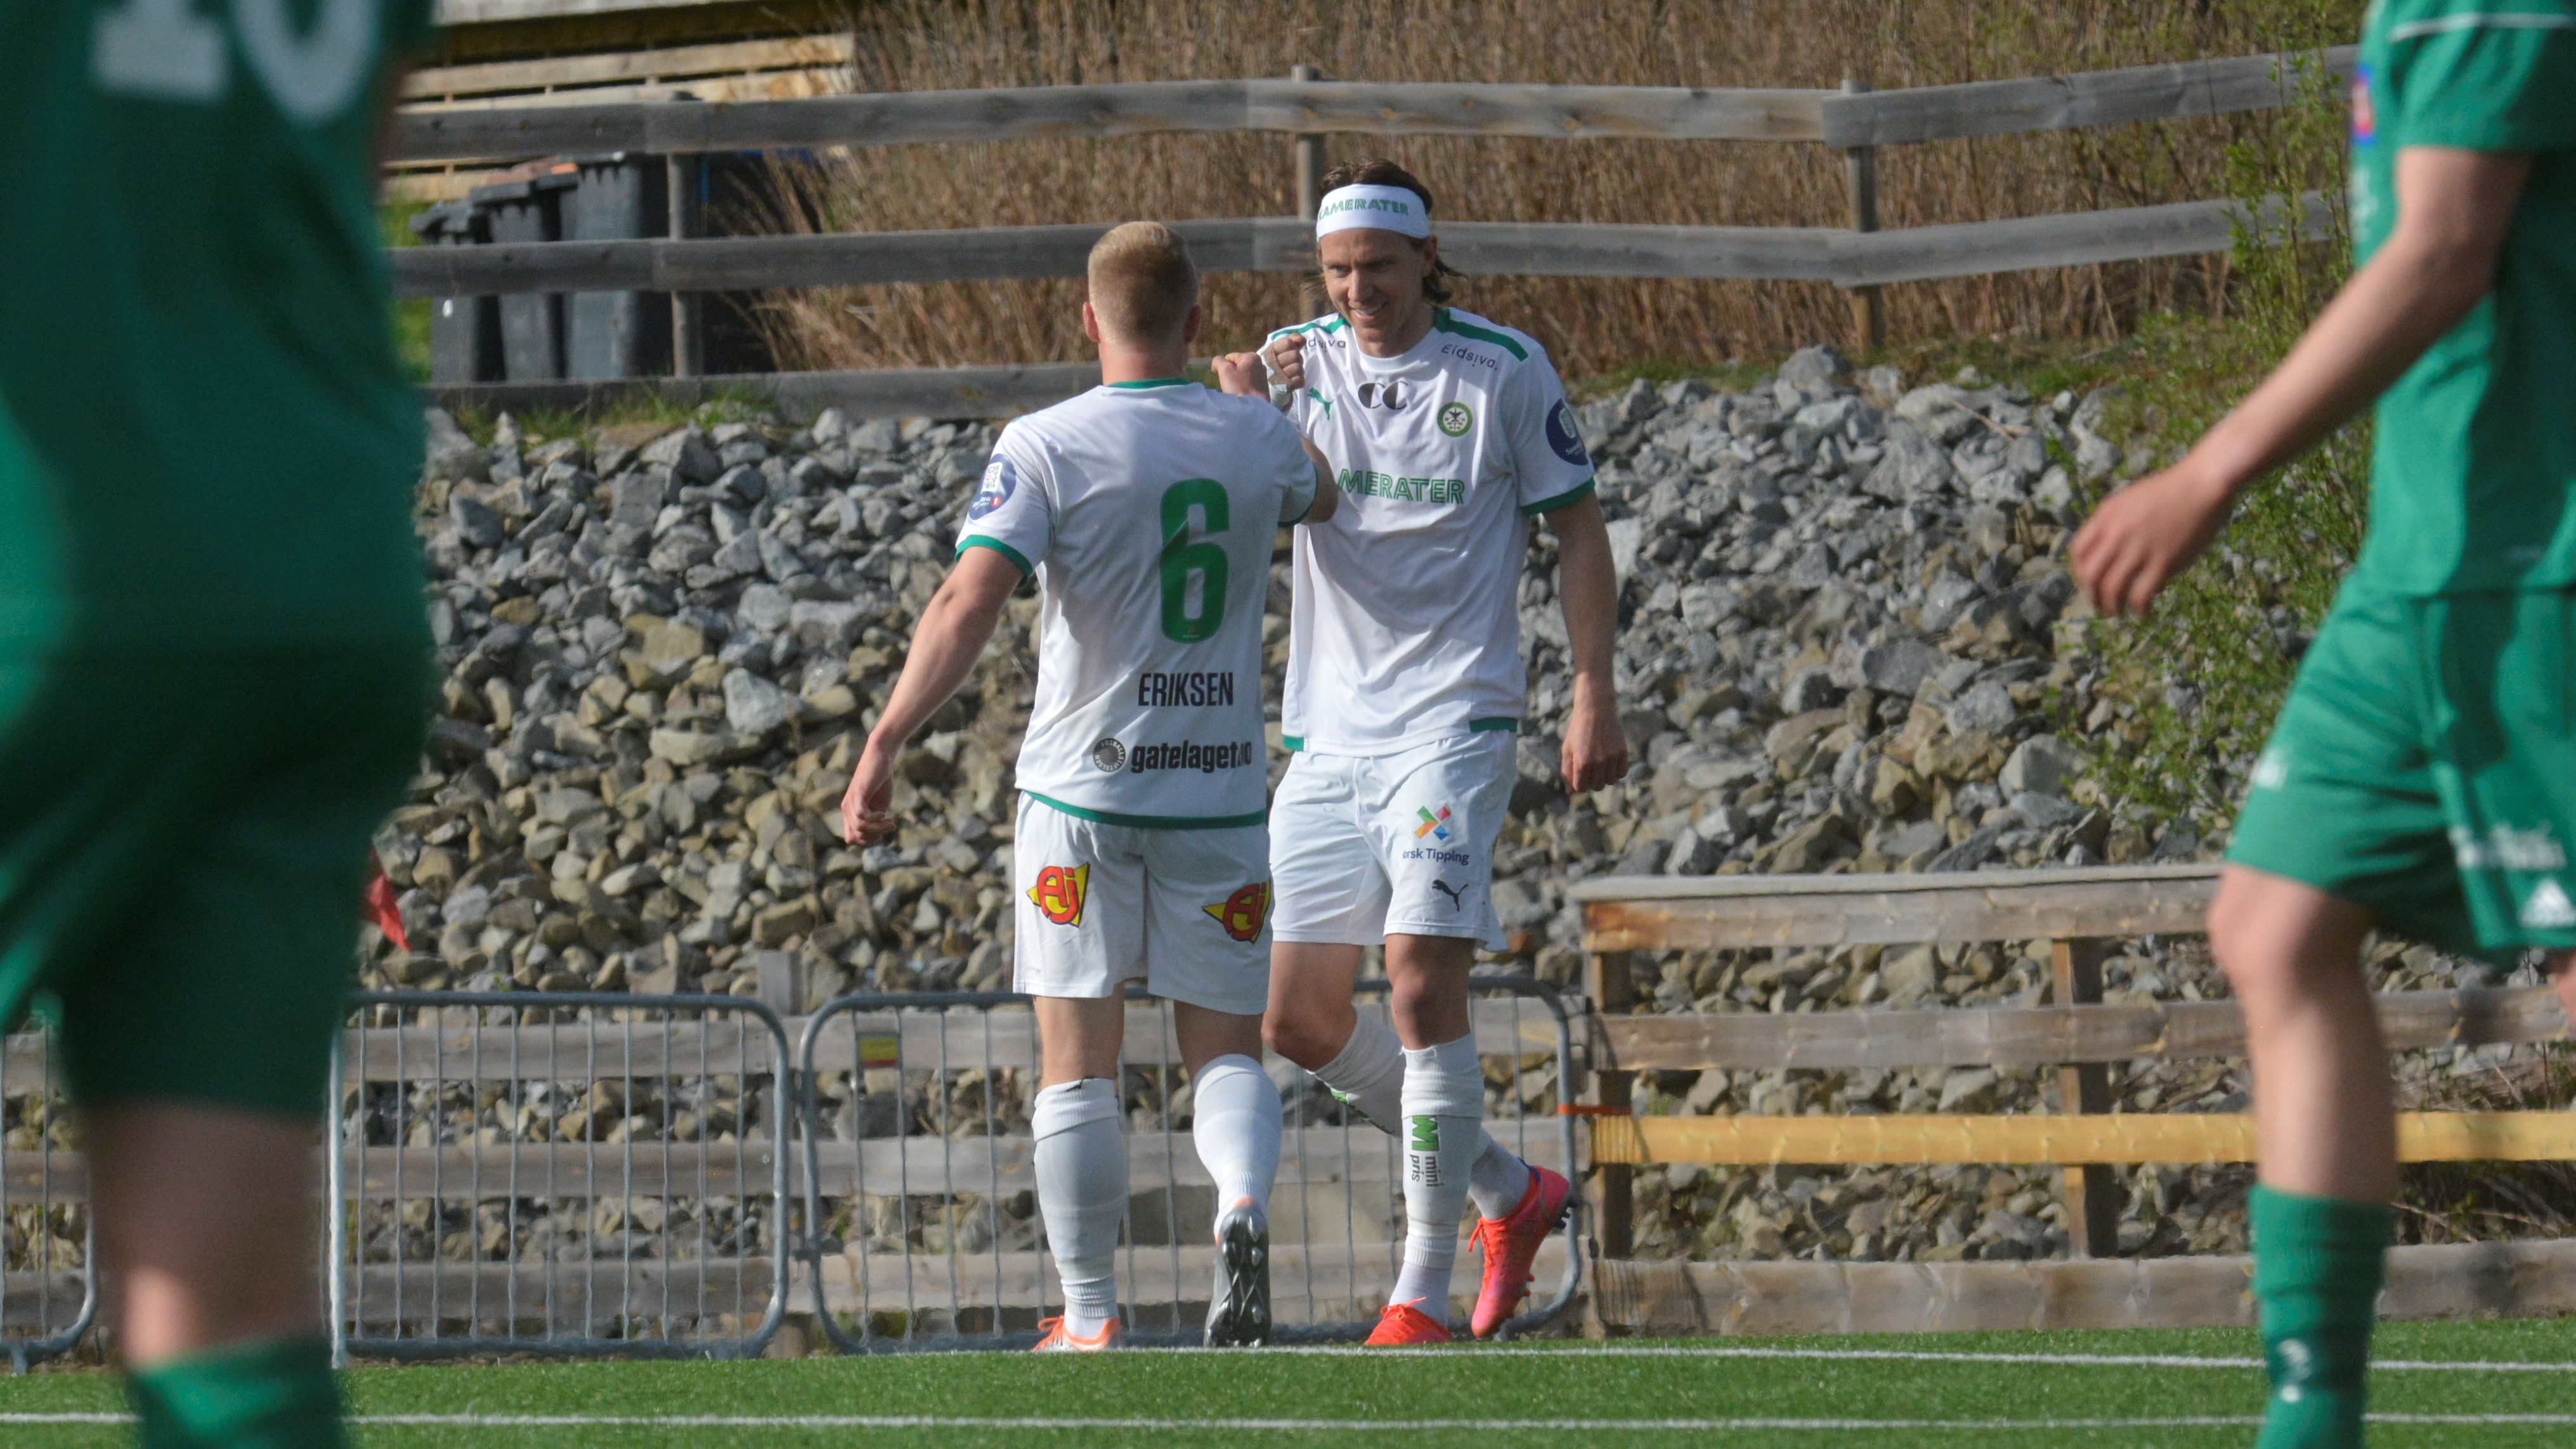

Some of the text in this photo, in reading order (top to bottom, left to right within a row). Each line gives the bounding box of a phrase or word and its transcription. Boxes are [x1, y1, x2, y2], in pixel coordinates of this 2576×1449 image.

[1337, 468, 1465, 504] MERATER
[1159, 478, 1230, 644] 6
[1138, 672, 1233, 706] ERIKSEN
[1426, 848, 1470, 866] Tipping
[1410, 1154, 1424, 1182] pris
[1425, 1156, 1444, 1187] mini
